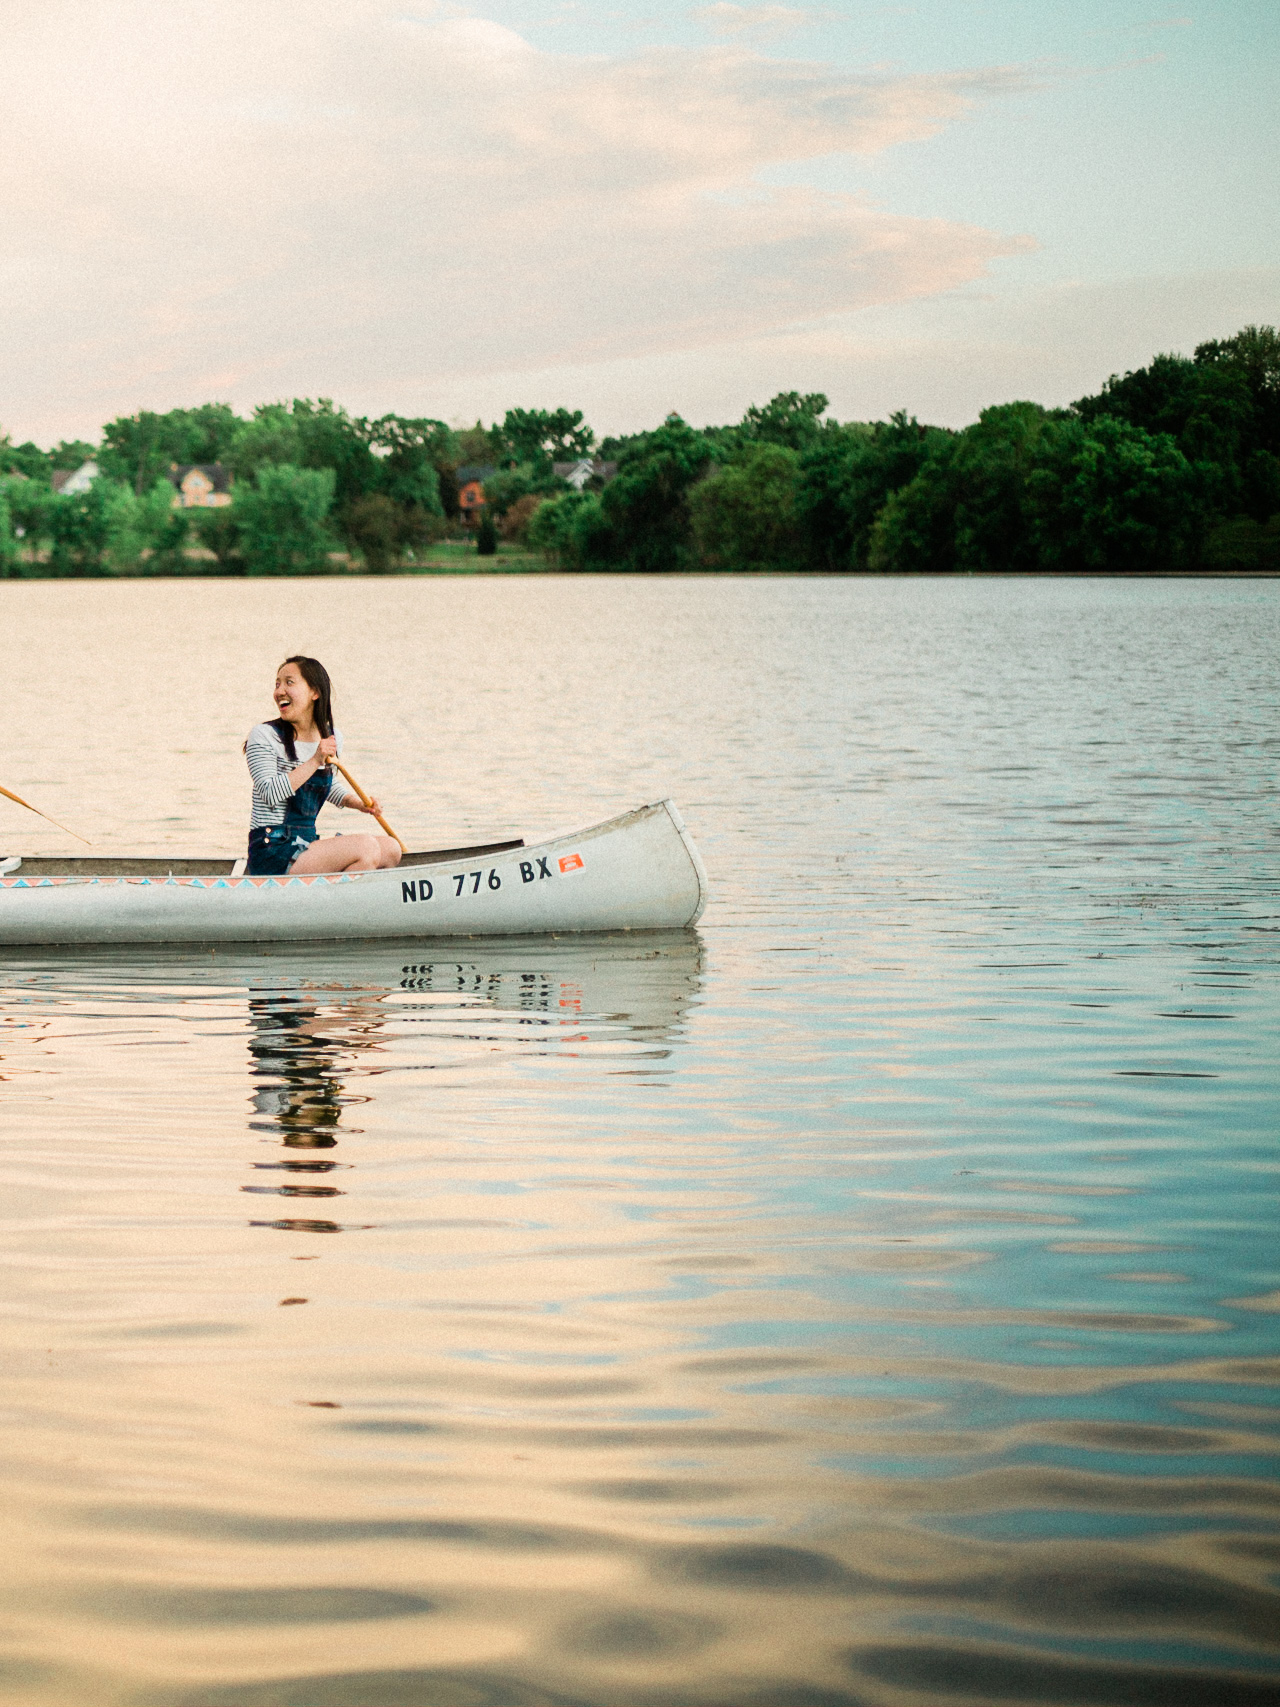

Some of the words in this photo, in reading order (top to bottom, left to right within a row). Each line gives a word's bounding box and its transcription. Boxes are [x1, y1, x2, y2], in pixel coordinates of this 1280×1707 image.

[401, 879, 433, 903] ND
[453, 869, 501, 896] 776
[519, 856, 552, 883] BX
